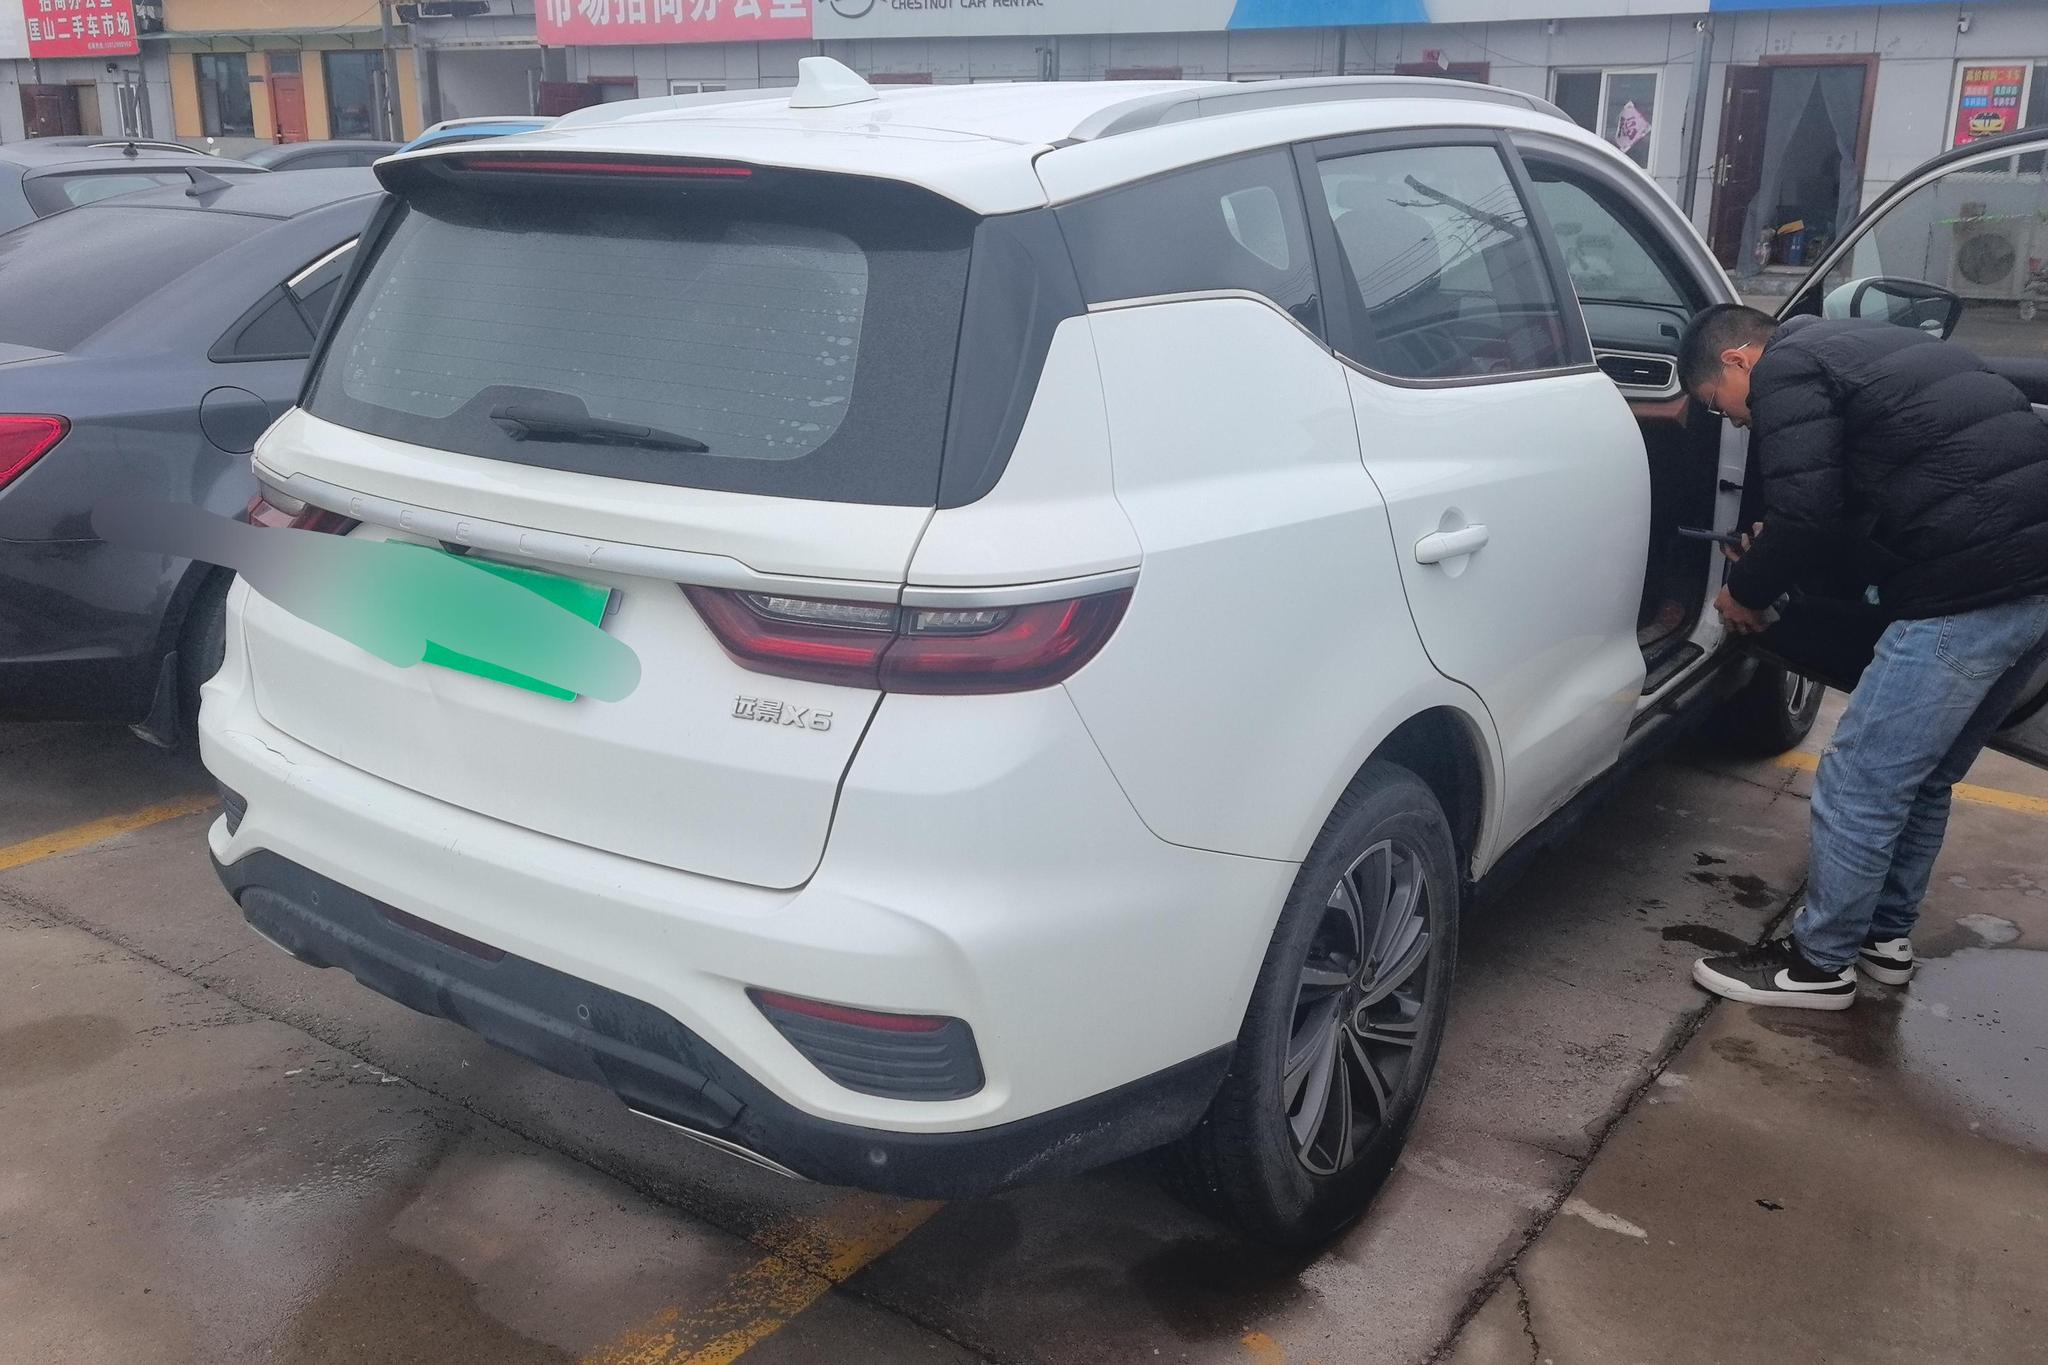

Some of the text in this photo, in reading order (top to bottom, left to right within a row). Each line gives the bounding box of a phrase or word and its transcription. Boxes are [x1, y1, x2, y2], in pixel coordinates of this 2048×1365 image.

[891, 0, 952, 10] CHESTNUT
[960, 0, 986, 8] CAR
[28, 12, 130, 41] 匡山二手车市场
[732, 695, 834, 732] 远景X6
